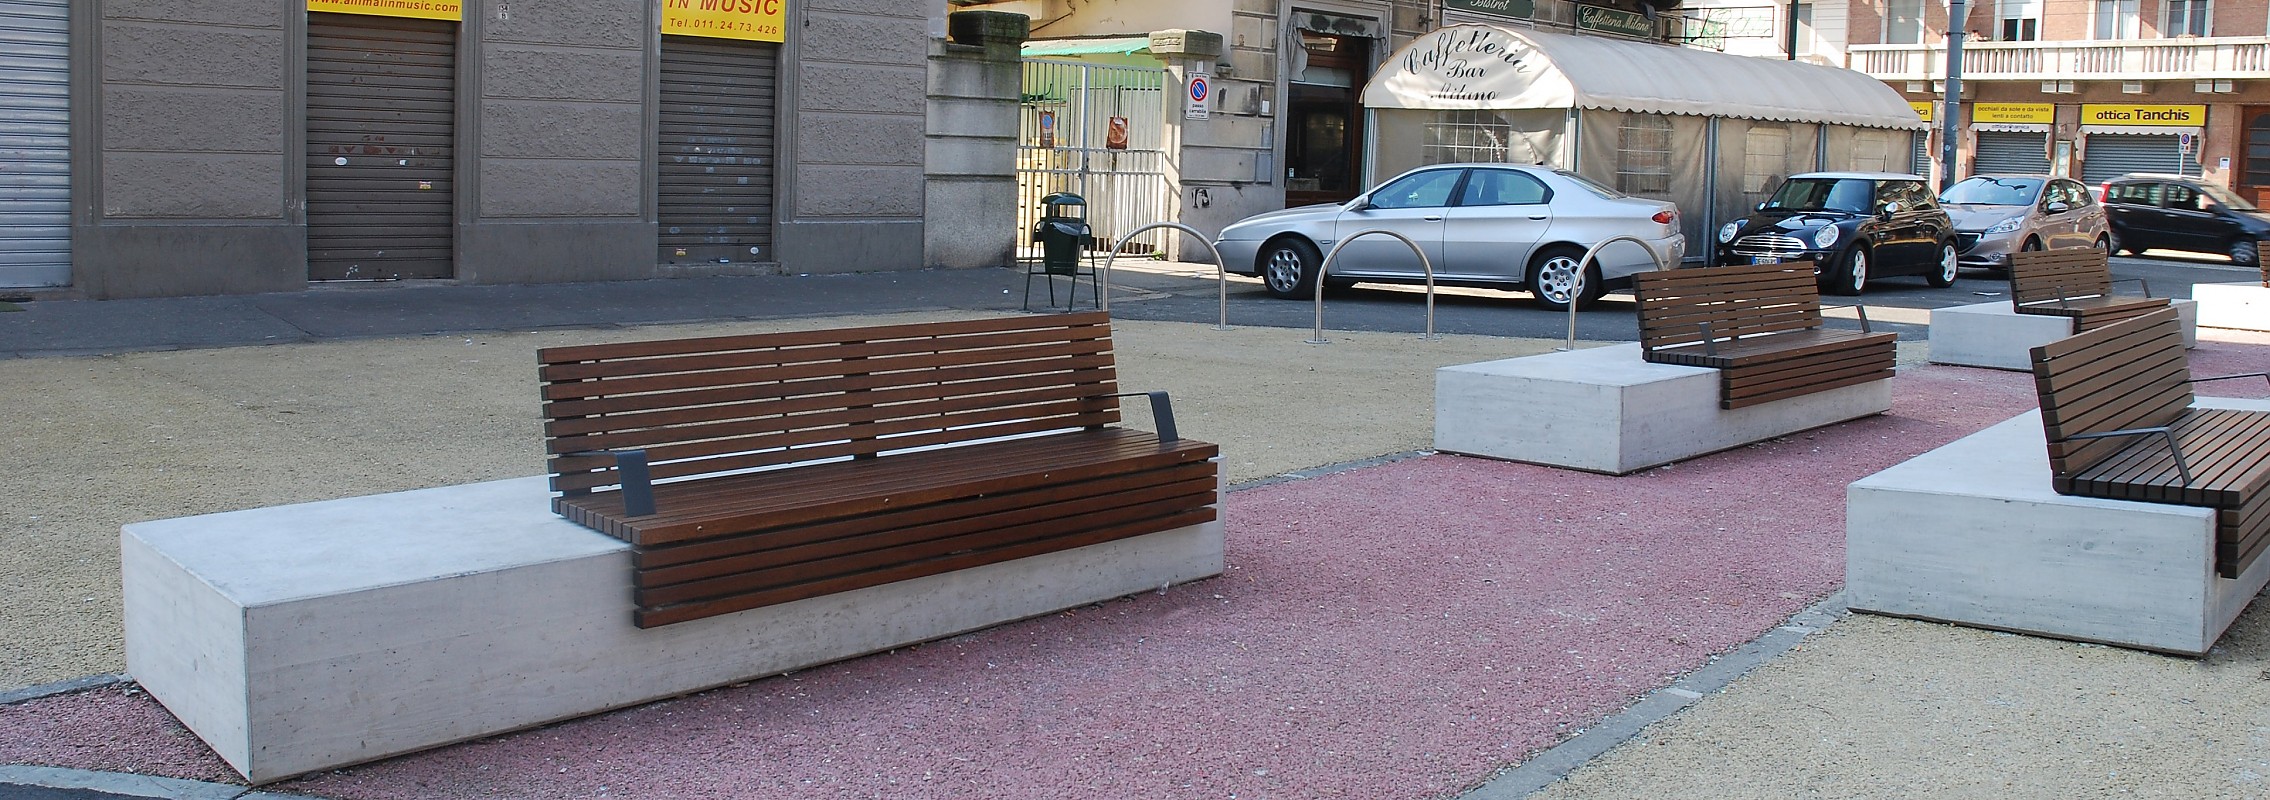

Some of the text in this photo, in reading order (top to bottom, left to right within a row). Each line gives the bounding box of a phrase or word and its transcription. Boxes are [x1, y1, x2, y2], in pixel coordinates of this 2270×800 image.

[310, 0, 459, 12] w.animalinmusic.com
[700, 0, 779, 16] MUSIC
[670, 18, 777, 34] Tel.011.24.73.426
[1582, 6, 1650, 32] Caffetteria Milano
[1403, 29, 1532, 76] Caffetteria
[1446, 58, 1488, 79] Bar
[1429, 82, 1500, 101] Milano
[2095, 109, 2190, 121] ottica Tanchis
